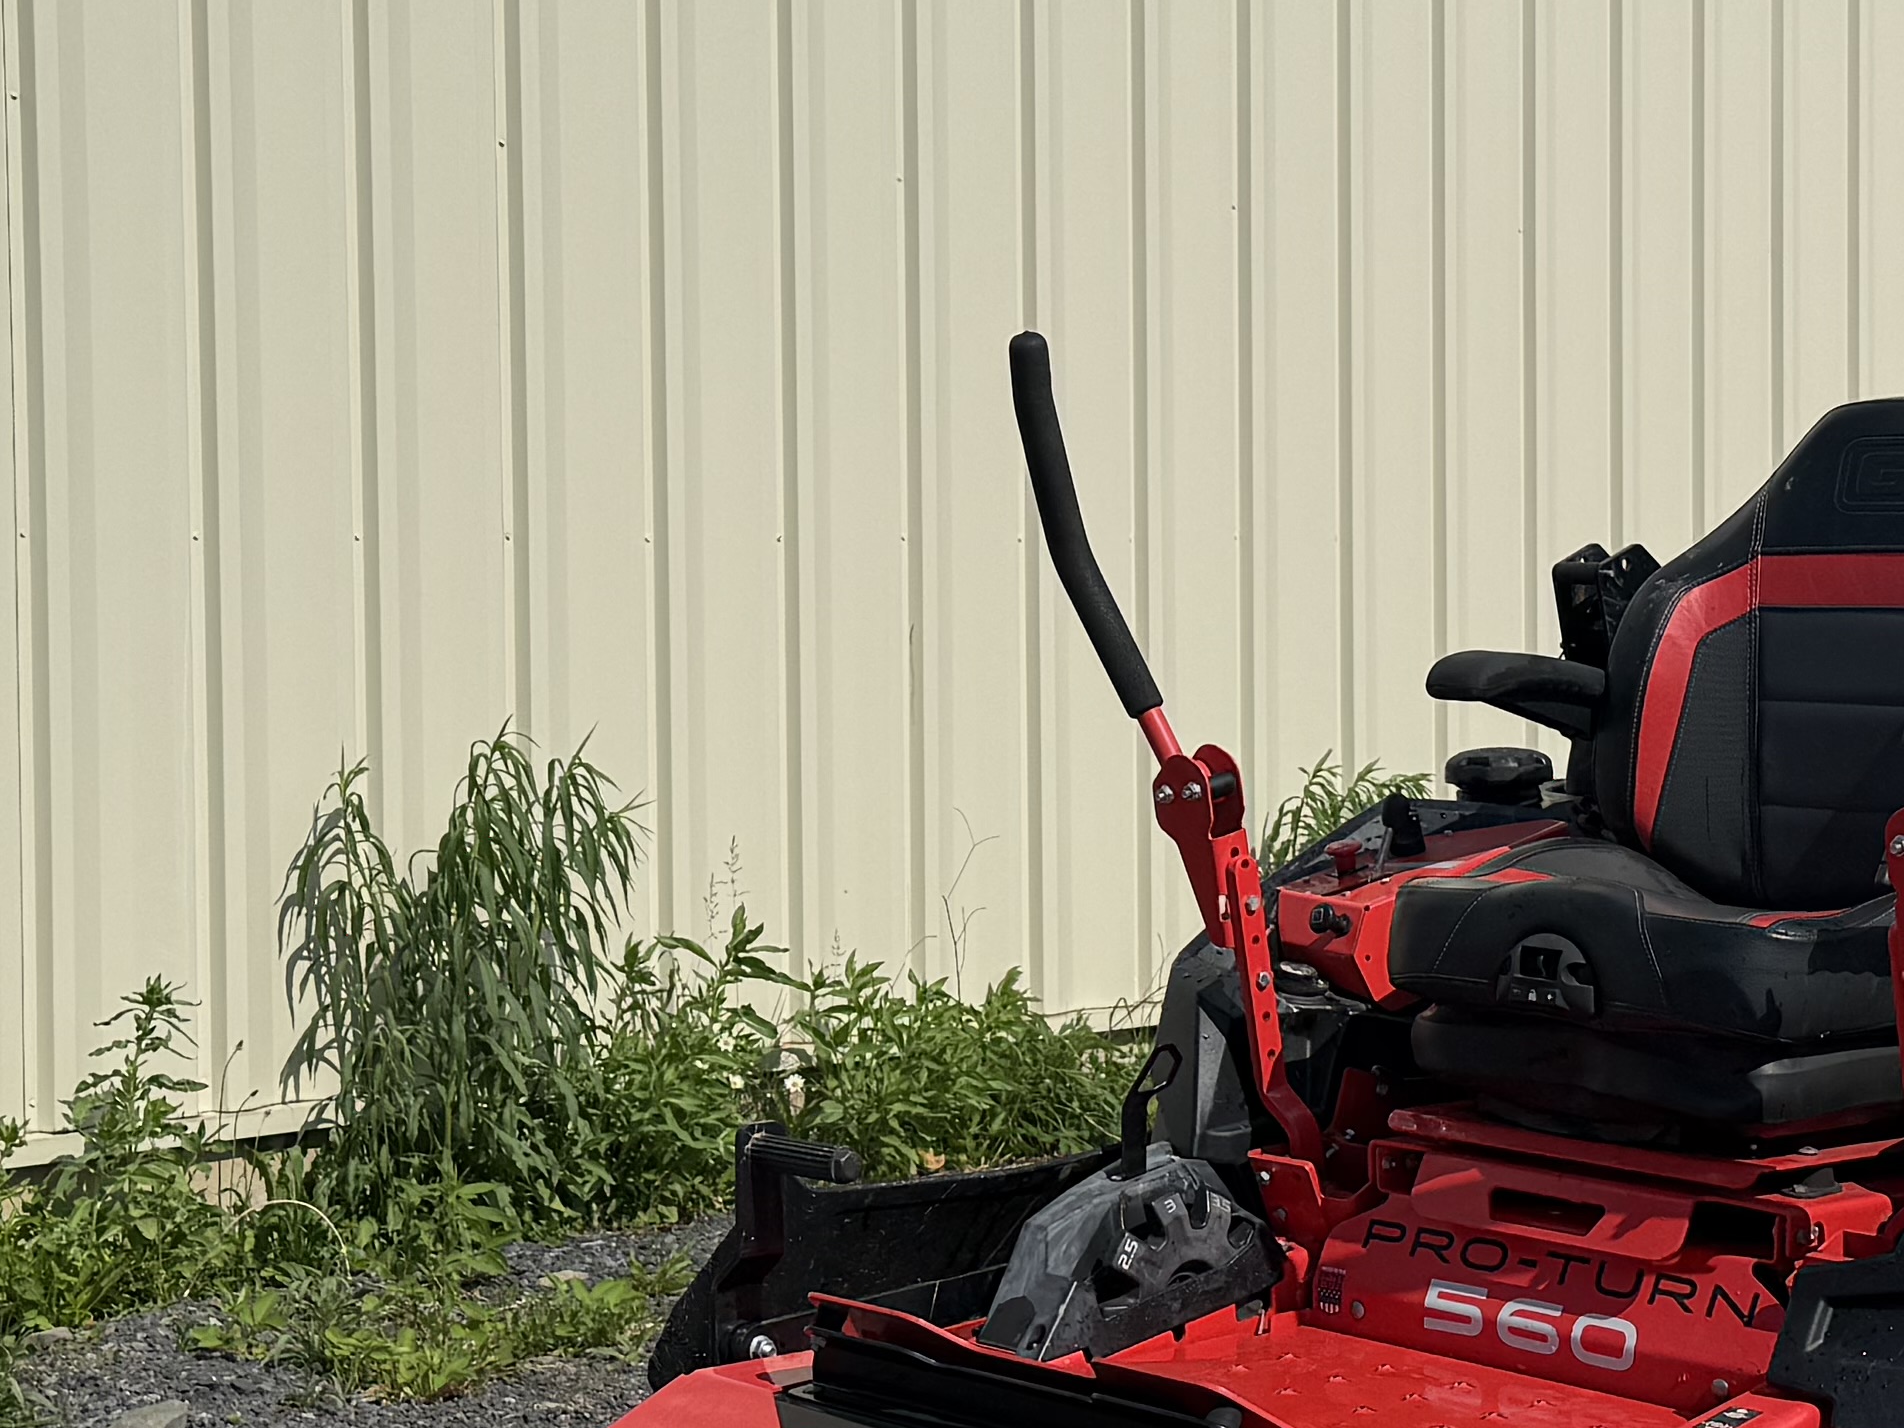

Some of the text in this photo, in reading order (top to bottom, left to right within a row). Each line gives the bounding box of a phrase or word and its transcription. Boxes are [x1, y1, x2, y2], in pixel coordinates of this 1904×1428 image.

[1163, 1198, 1178, 1214] 3
[1116, 1237, 1139, 1271] 2.5
[1361, 1218, 1761, 1329] PRO-TURN
[1423, 1278, 1638, 1372] 560
